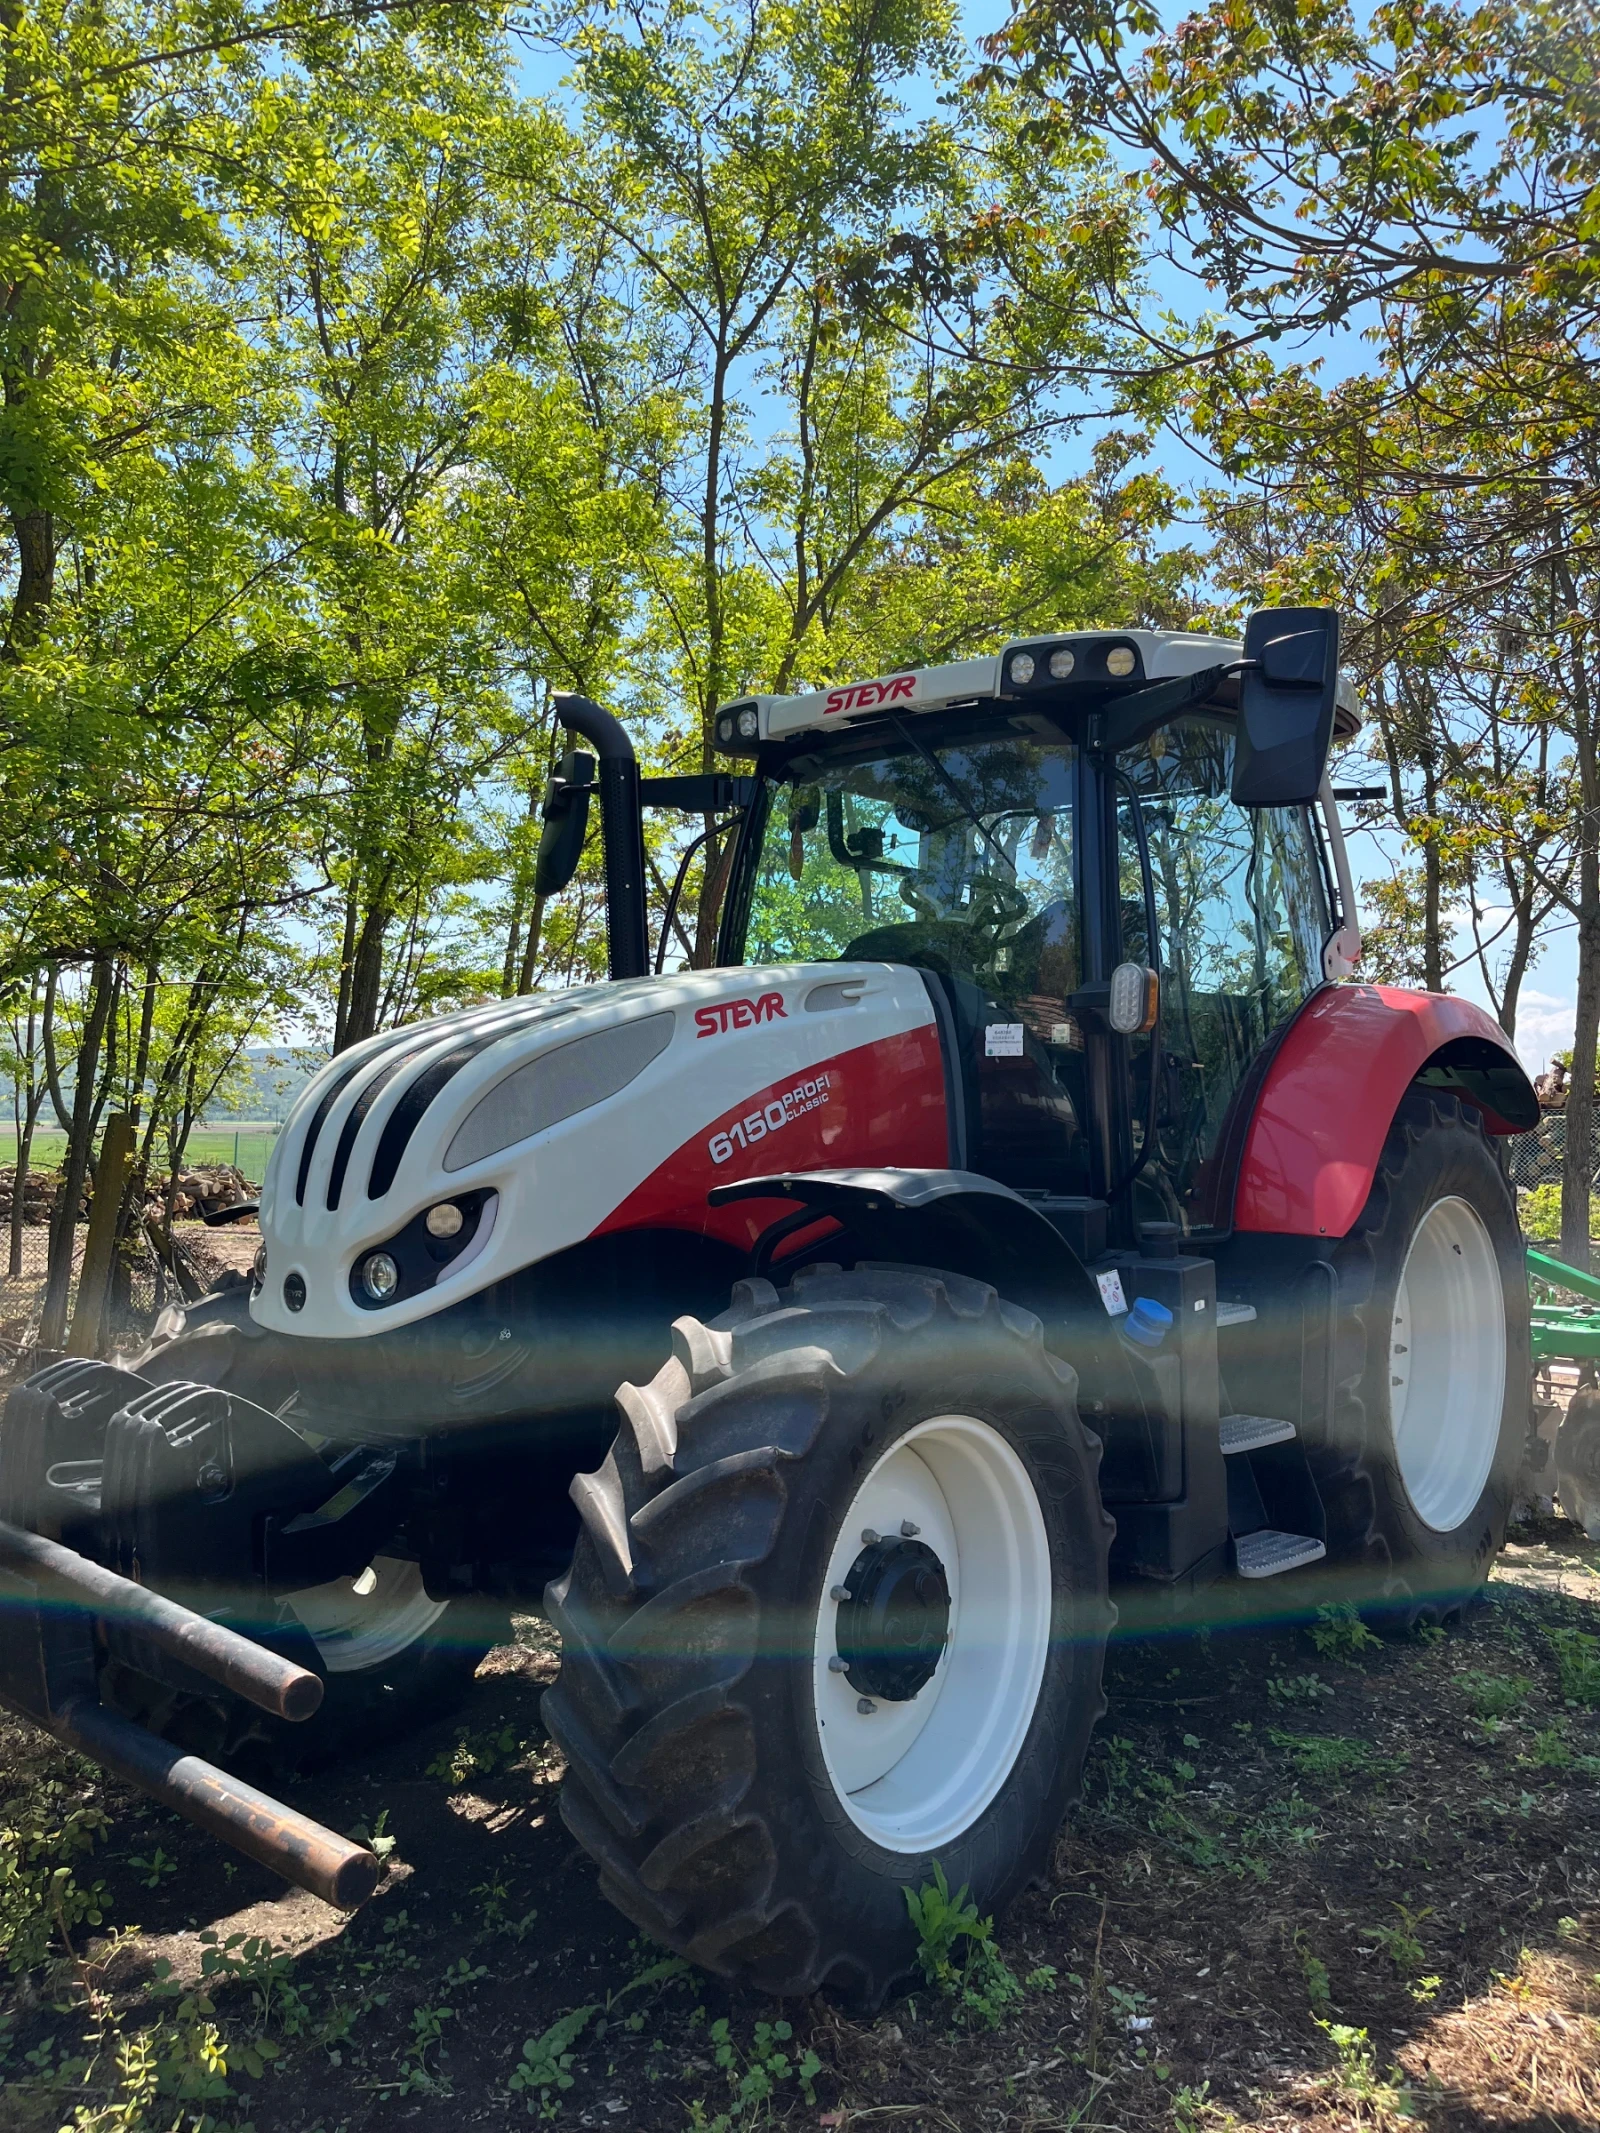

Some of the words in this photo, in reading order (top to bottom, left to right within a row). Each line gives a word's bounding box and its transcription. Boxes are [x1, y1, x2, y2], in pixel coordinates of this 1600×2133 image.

[823, 675, 917, 714] STEYR
[694, 992, 788, 1038] STEYR
[708, 1100, 787, 1165] 6150
[782, 1074, 831, 1108] PROFI
[786, 1093, 829, 1122] CLASSIC
